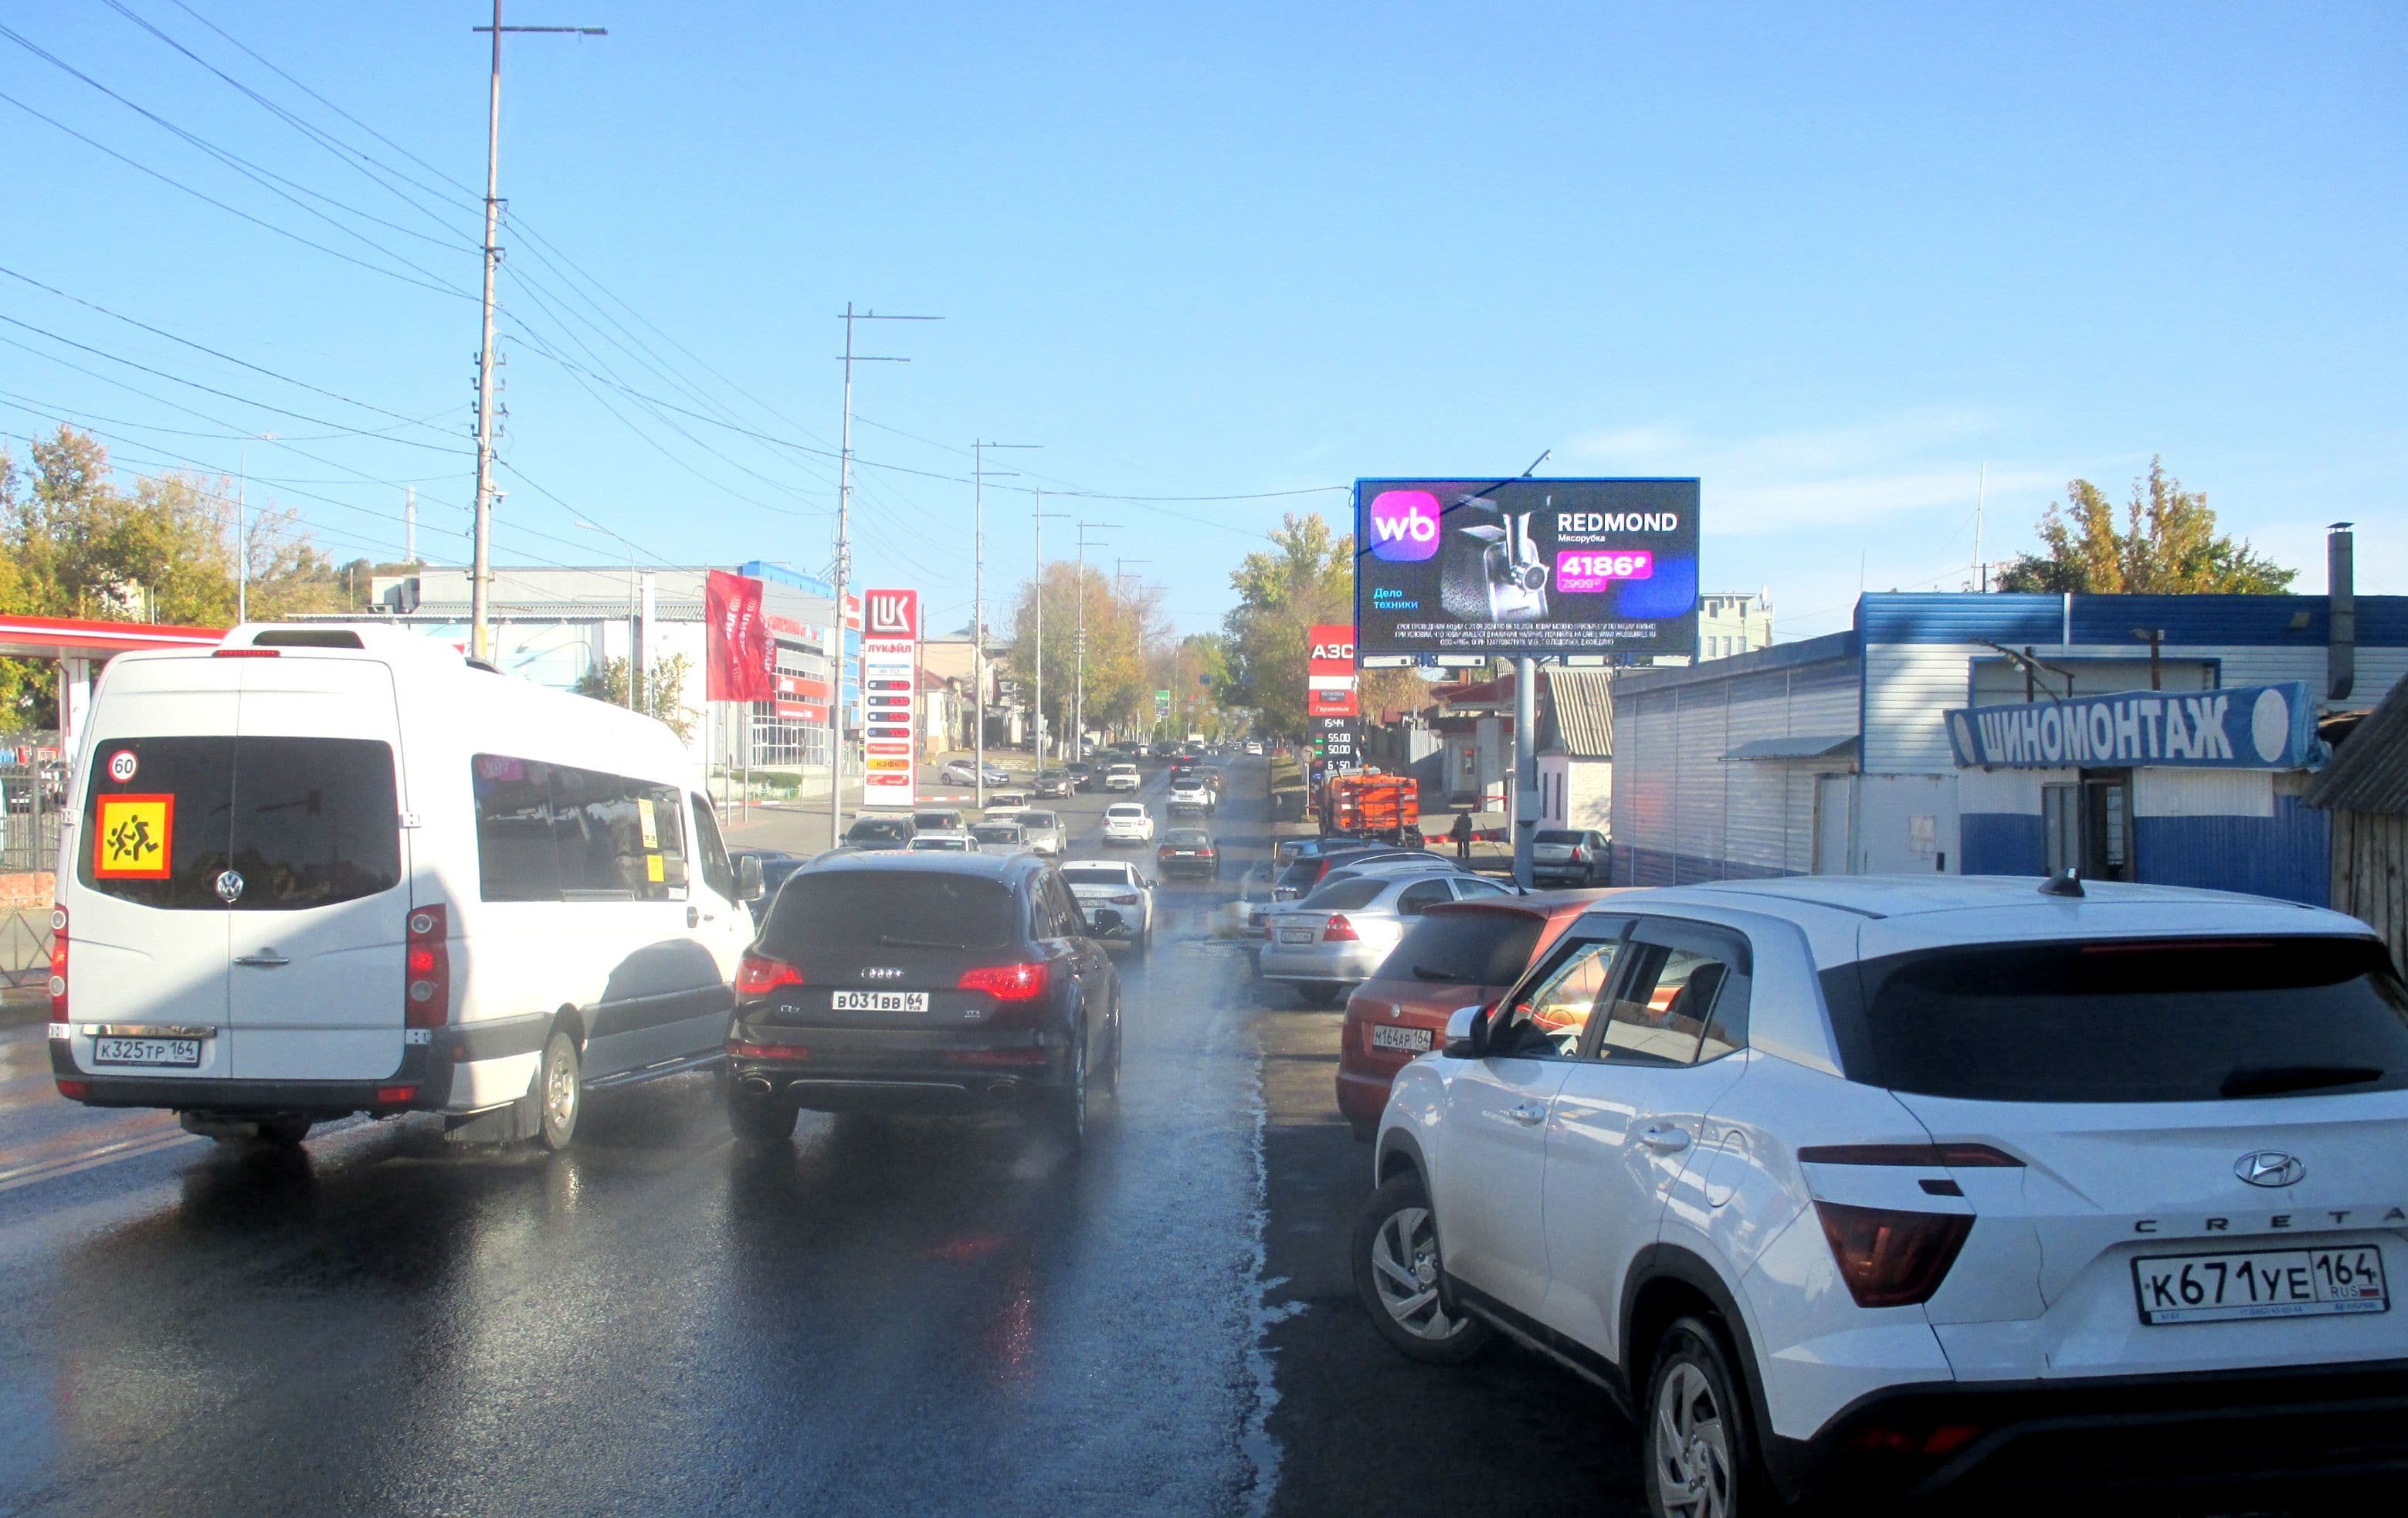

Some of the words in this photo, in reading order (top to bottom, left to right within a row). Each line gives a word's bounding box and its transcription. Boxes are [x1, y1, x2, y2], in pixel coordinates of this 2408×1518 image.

[1375, 507, 1435, 541] wb
[1558, 513, 1677, 532] REDMOND
[1558, 534, 1606, 544] Мясорубка
[1374, 588, 1402, 599] Дело
[1374, 601, 1419, 609] техники
[1311, 643, 1354, 659] АЗС
[1324, 719, 1344, 727] 15:44
[1977, 696, 2234, 762] ШИНОМОНТАЖ
[1328, 734, 1351, 742] 55.00
[1328, 745, 1351, 754] 50.00
[115, 758, 134, 774] 60
[837, 993, 900, 1009] В031ВВ
[907, 993, 924, 1005] 64
[101, 1041, 164, 1059] К325ТР
[170, 1042, 193, 1055] 164
[2134, 1207, 2406, 1232] CRETA
[2152, 1260, 2311, 1306] К671УЕ
[2316, 1252, 2377, 1286] 164
[2329, 1284, 2359, 1297] RUS
